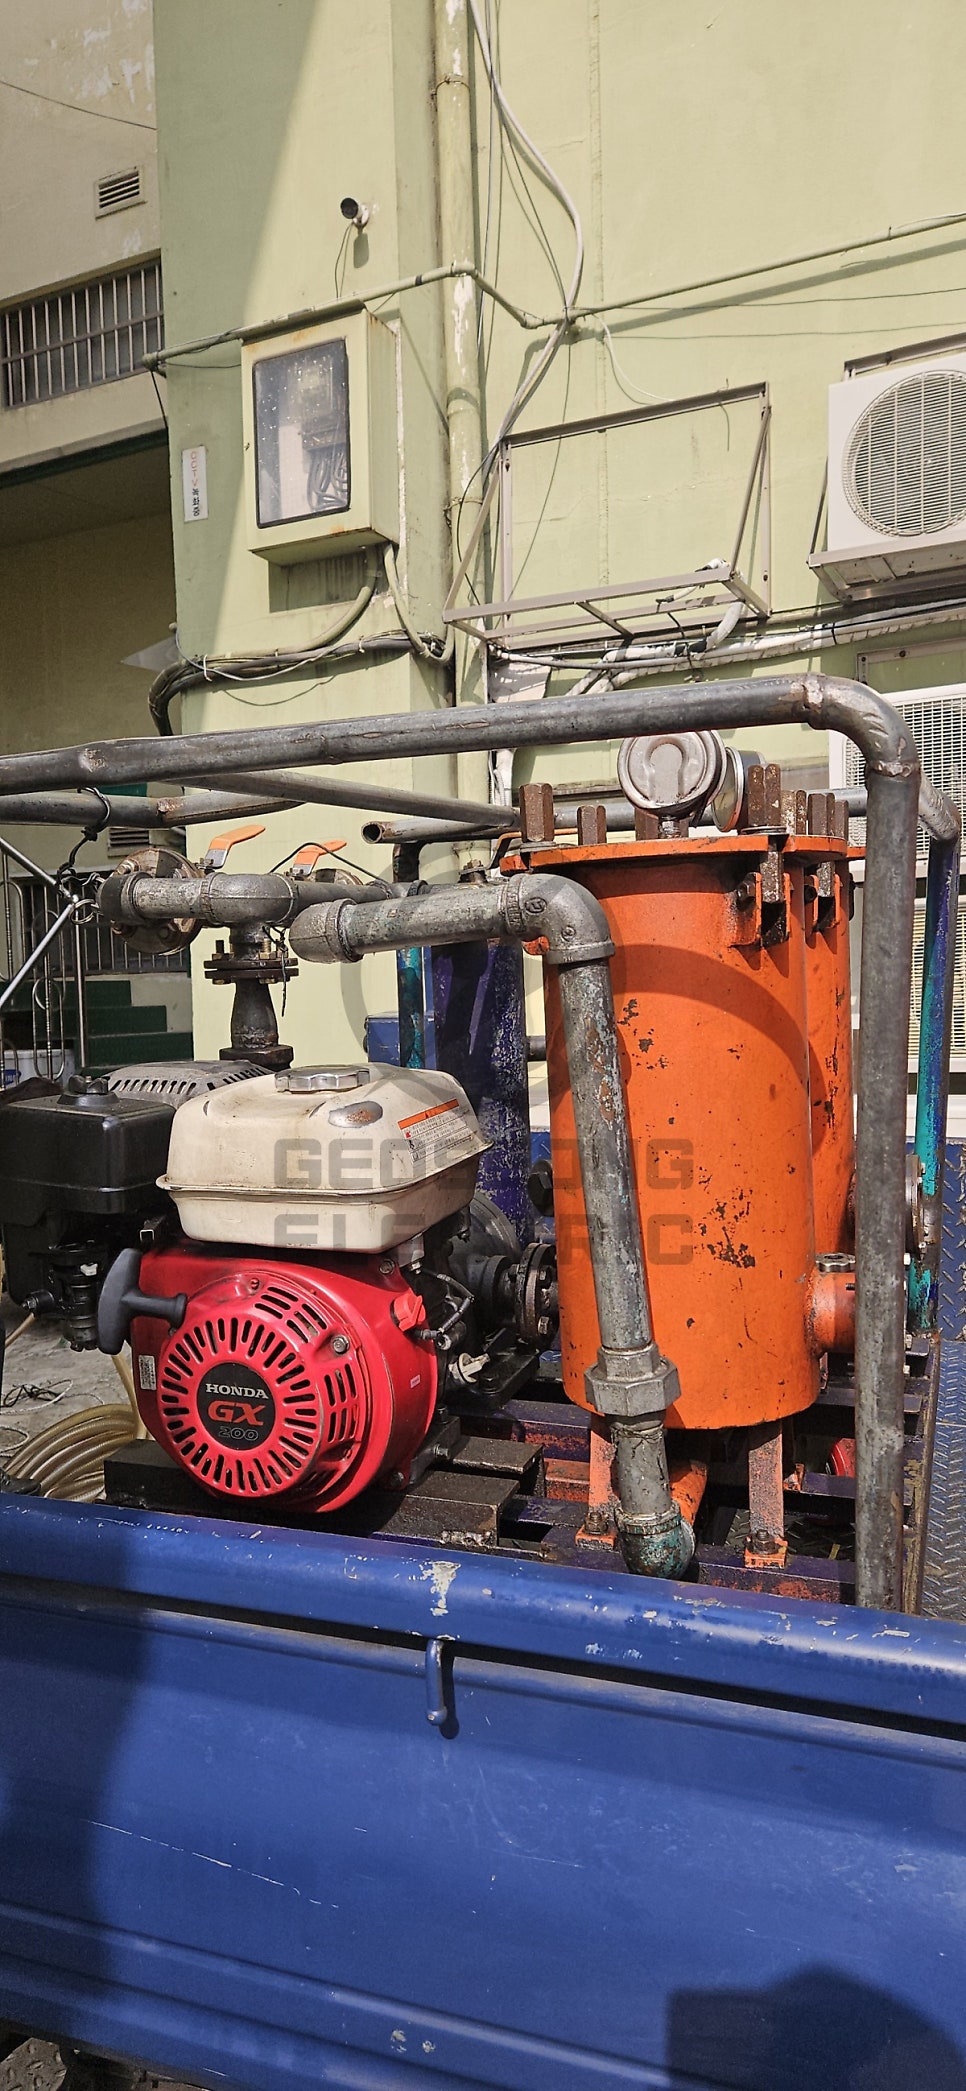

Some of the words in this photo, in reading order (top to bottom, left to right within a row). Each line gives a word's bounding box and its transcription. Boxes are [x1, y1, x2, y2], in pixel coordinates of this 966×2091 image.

[190, 451, 198, 487] CCTV
[205, 1383, 269, 1399] HONDA
[208, 1400, 266, 1426] GX
[218, 1426, 259, 1441] 200
